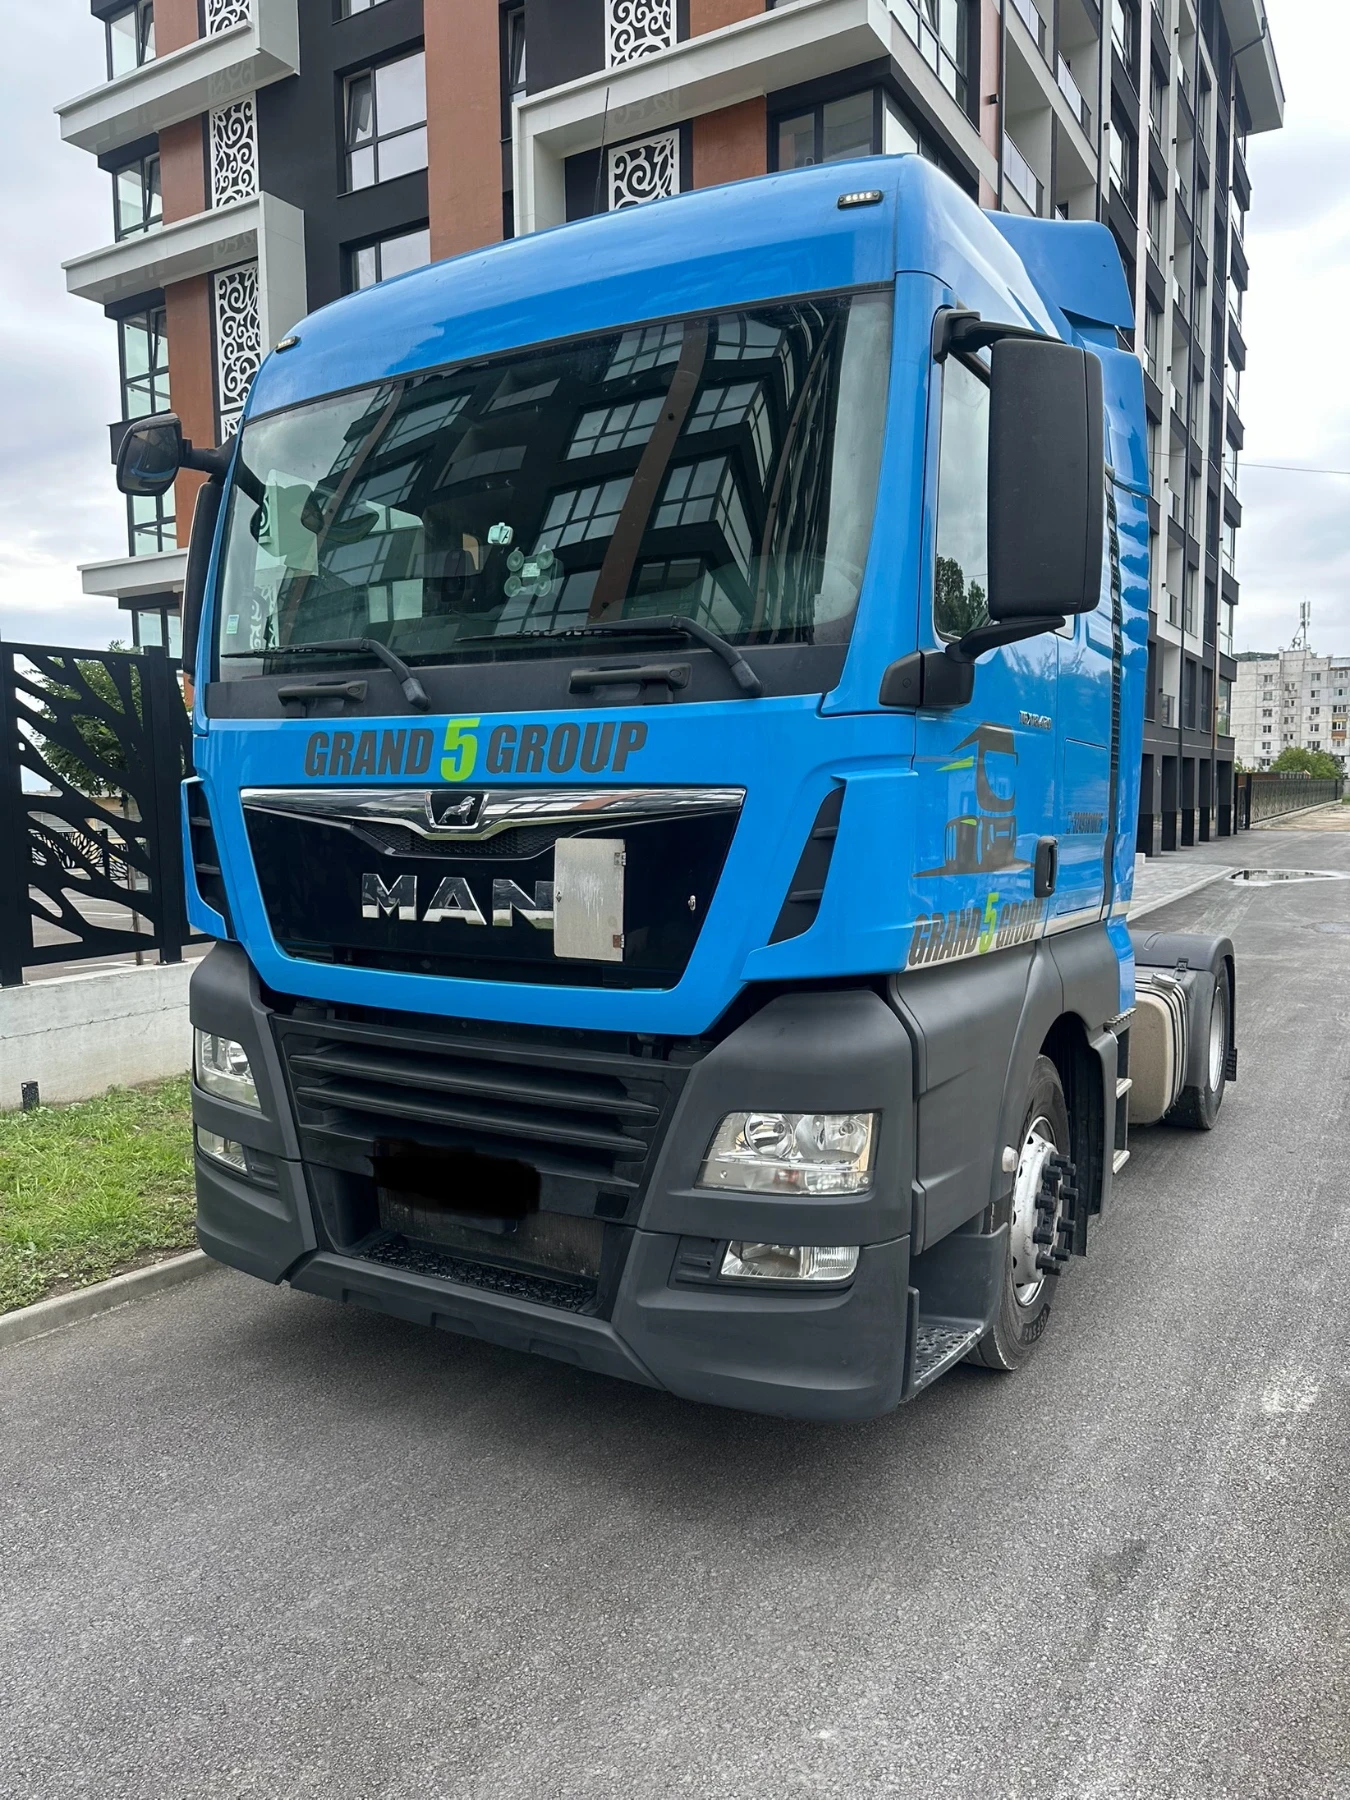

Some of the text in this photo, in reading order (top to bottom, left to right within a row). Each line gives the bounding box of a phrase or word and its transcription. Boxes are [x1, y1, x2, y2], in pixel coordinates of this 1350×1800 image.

[304, 717, 648, 782] GRAND 5 GROUP
[362, 873, 555, 930] MAN
[908, 891, 1043, 967] GRAND 5 GROUP
